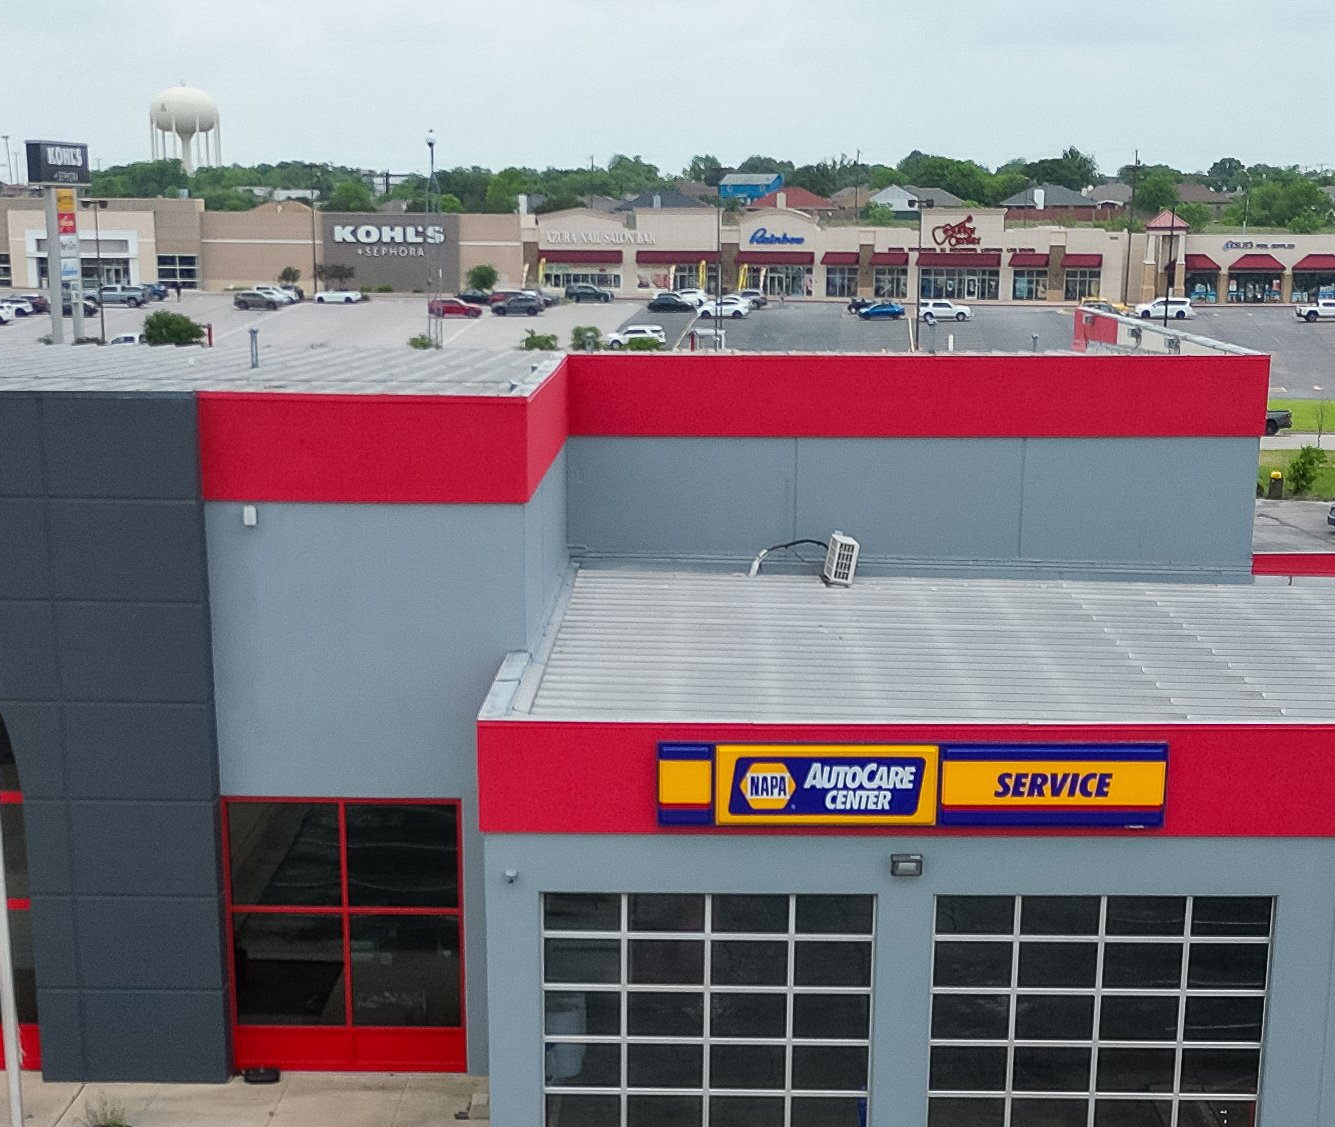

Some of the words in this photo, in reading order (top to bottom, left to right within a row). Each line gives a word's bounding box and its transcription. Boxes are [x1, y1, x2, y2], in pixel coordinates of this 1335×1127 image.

[333, 225, 445, 244] KOHL'S
[750, 775, 787, 797] NAPA
[994, 773, 1113, 798] SERVICE
[825, 790, 892, 810] CENTER
